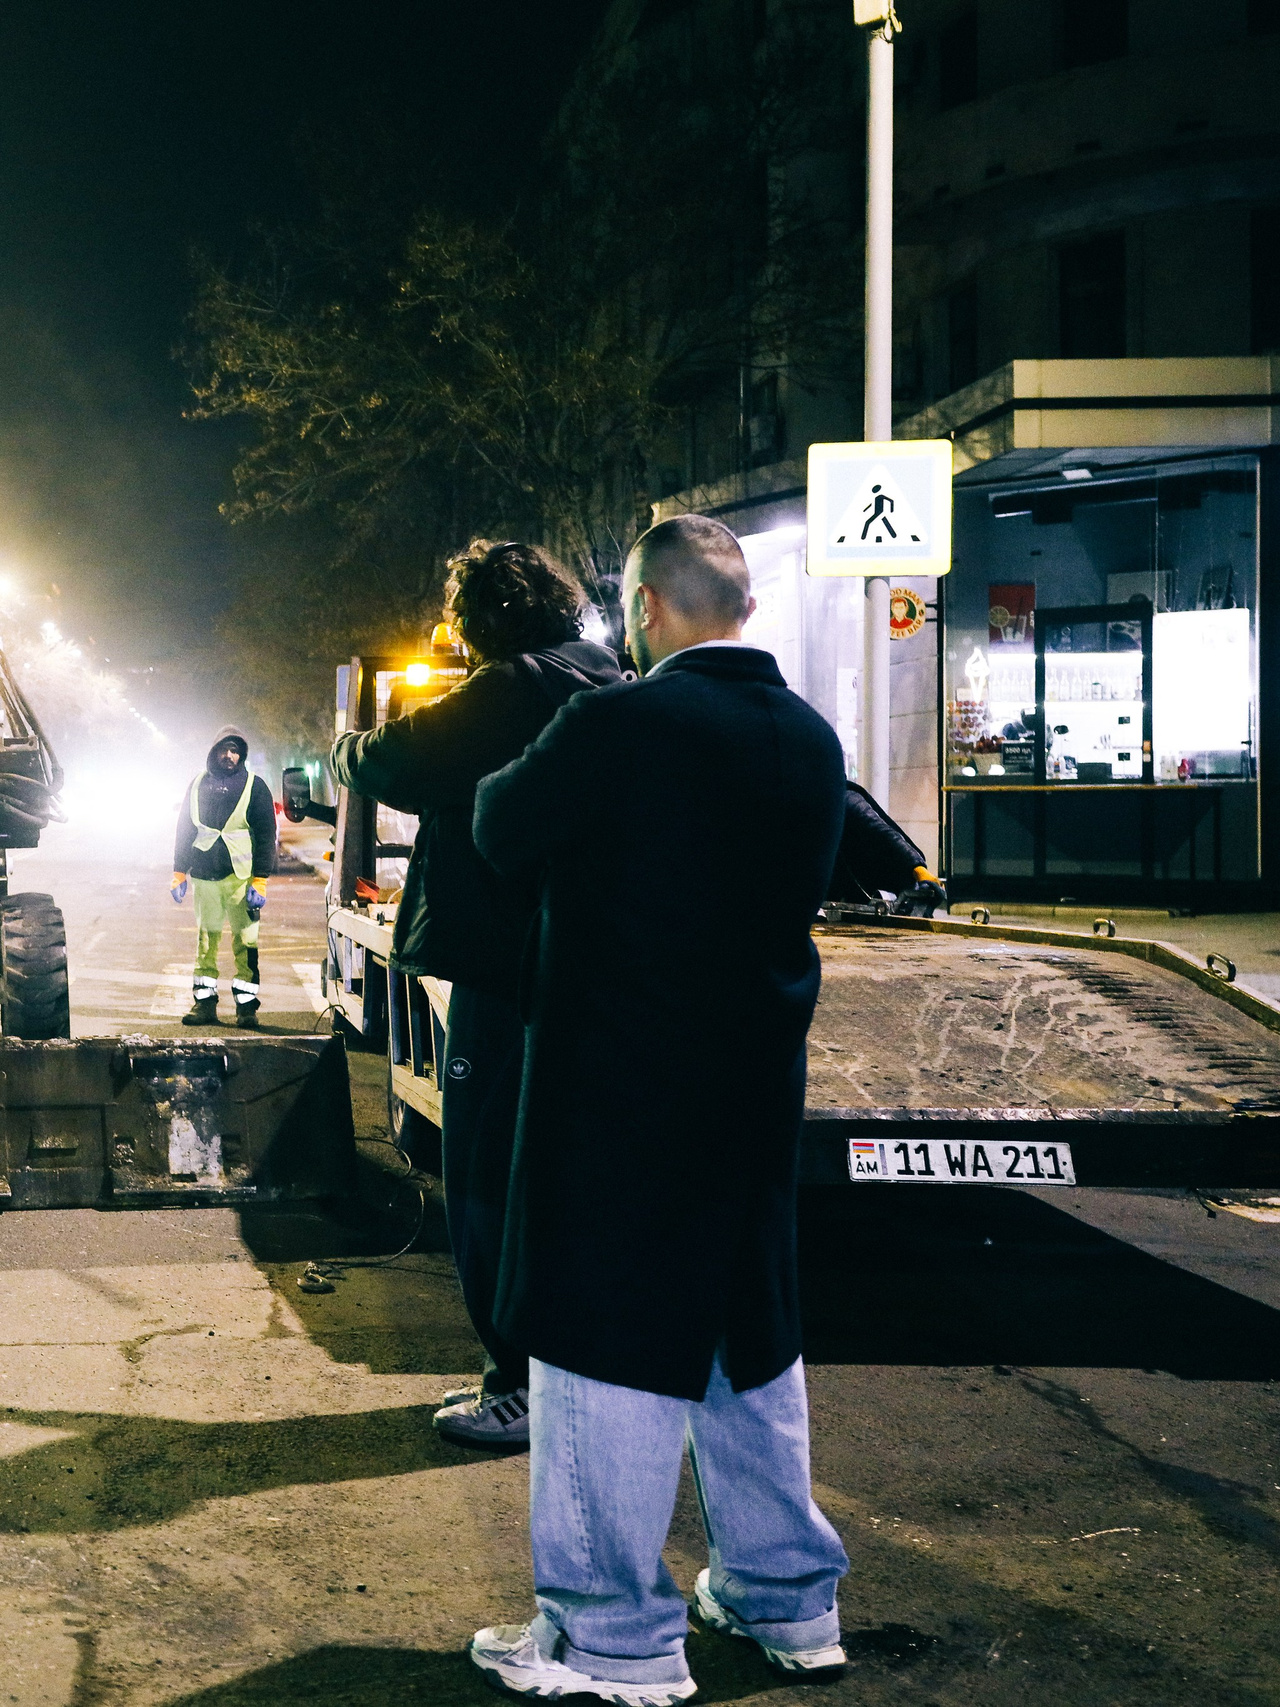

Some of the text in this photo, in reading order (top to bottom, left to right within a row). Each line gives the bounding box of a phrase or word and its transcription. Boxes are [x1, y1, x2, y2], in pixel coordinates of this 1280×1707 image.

[856, 1142, 1065, 1180] AM 11 WA 211
